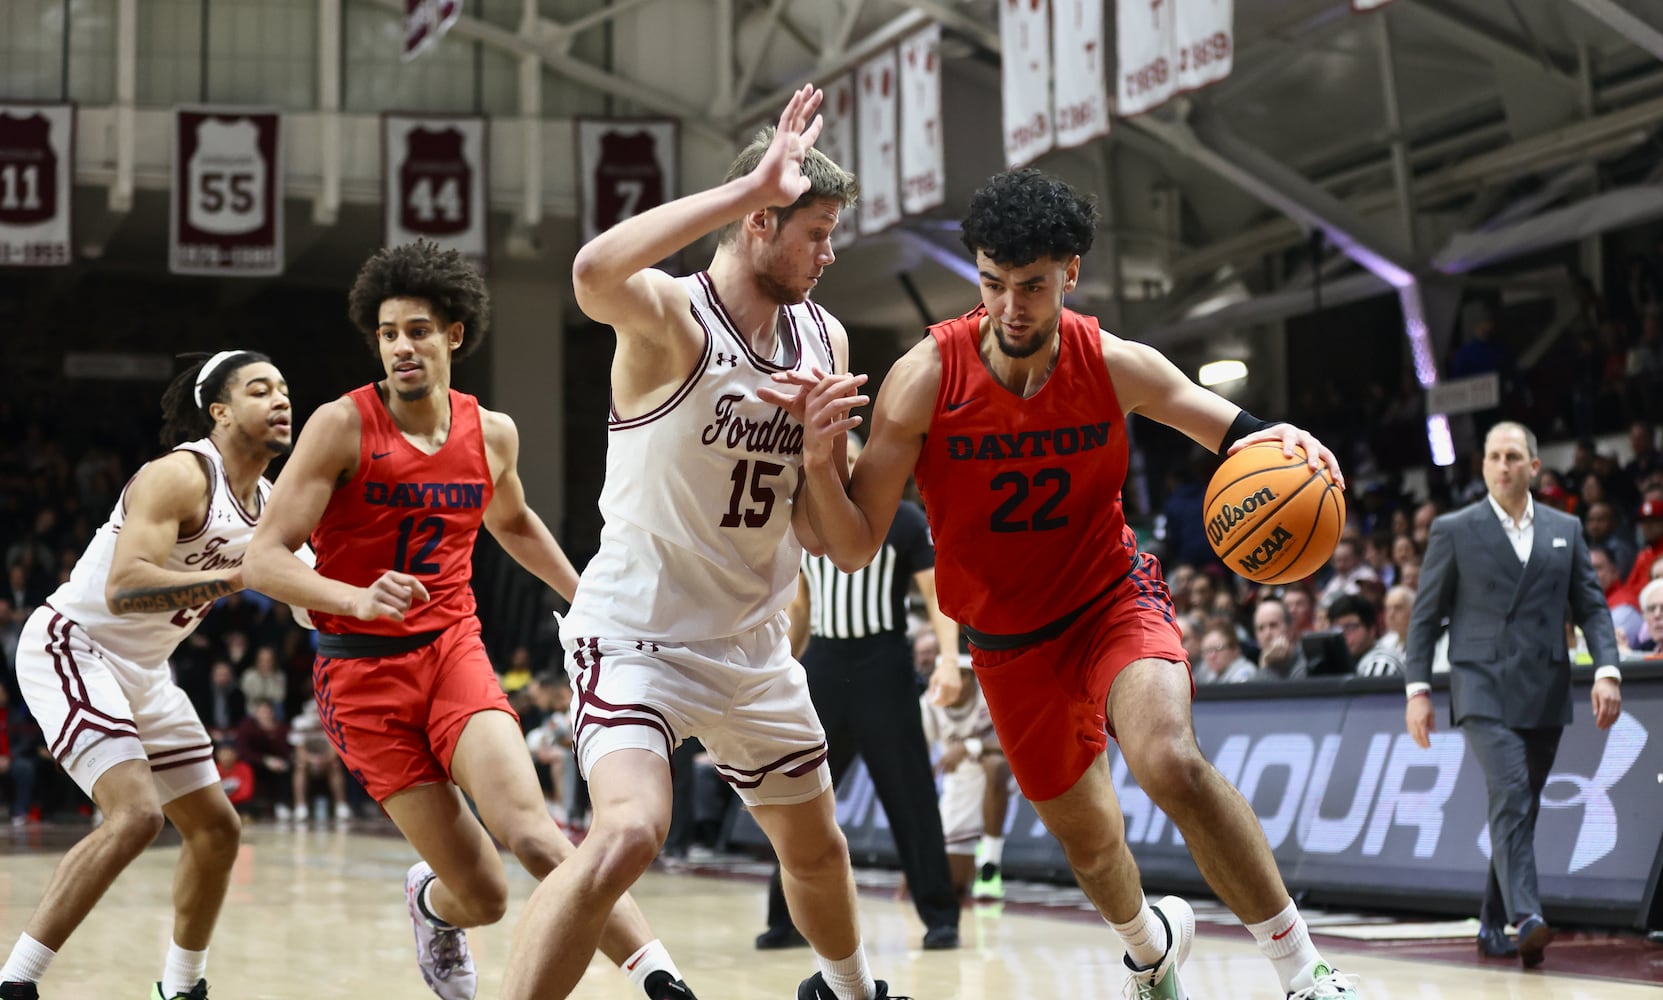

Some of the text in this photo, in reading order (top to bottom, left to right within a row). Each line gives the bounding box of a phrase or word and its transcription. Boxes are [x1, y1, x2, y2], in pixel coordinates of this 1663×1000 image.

[1, 164, 42, 210] 11
[200, 172, 254, 214] 55
[408, 177, 462, 222] 44
[614, 180, 644, 221] 7
[702, 394, 805, 456] Fordha
[946, 421, 1112, 461] DAYTON
[363, 481, 486, 509] DAYTON
[719, 459, 786, 528] 15
[990, 467, 1071, 533] 22
[1207, 486, 1277, 547] Wilson
[184, 536, 247, 571] Ford
[394, 515, 446, 574] 12
[1238, 525, 1294, 573] NCAA
